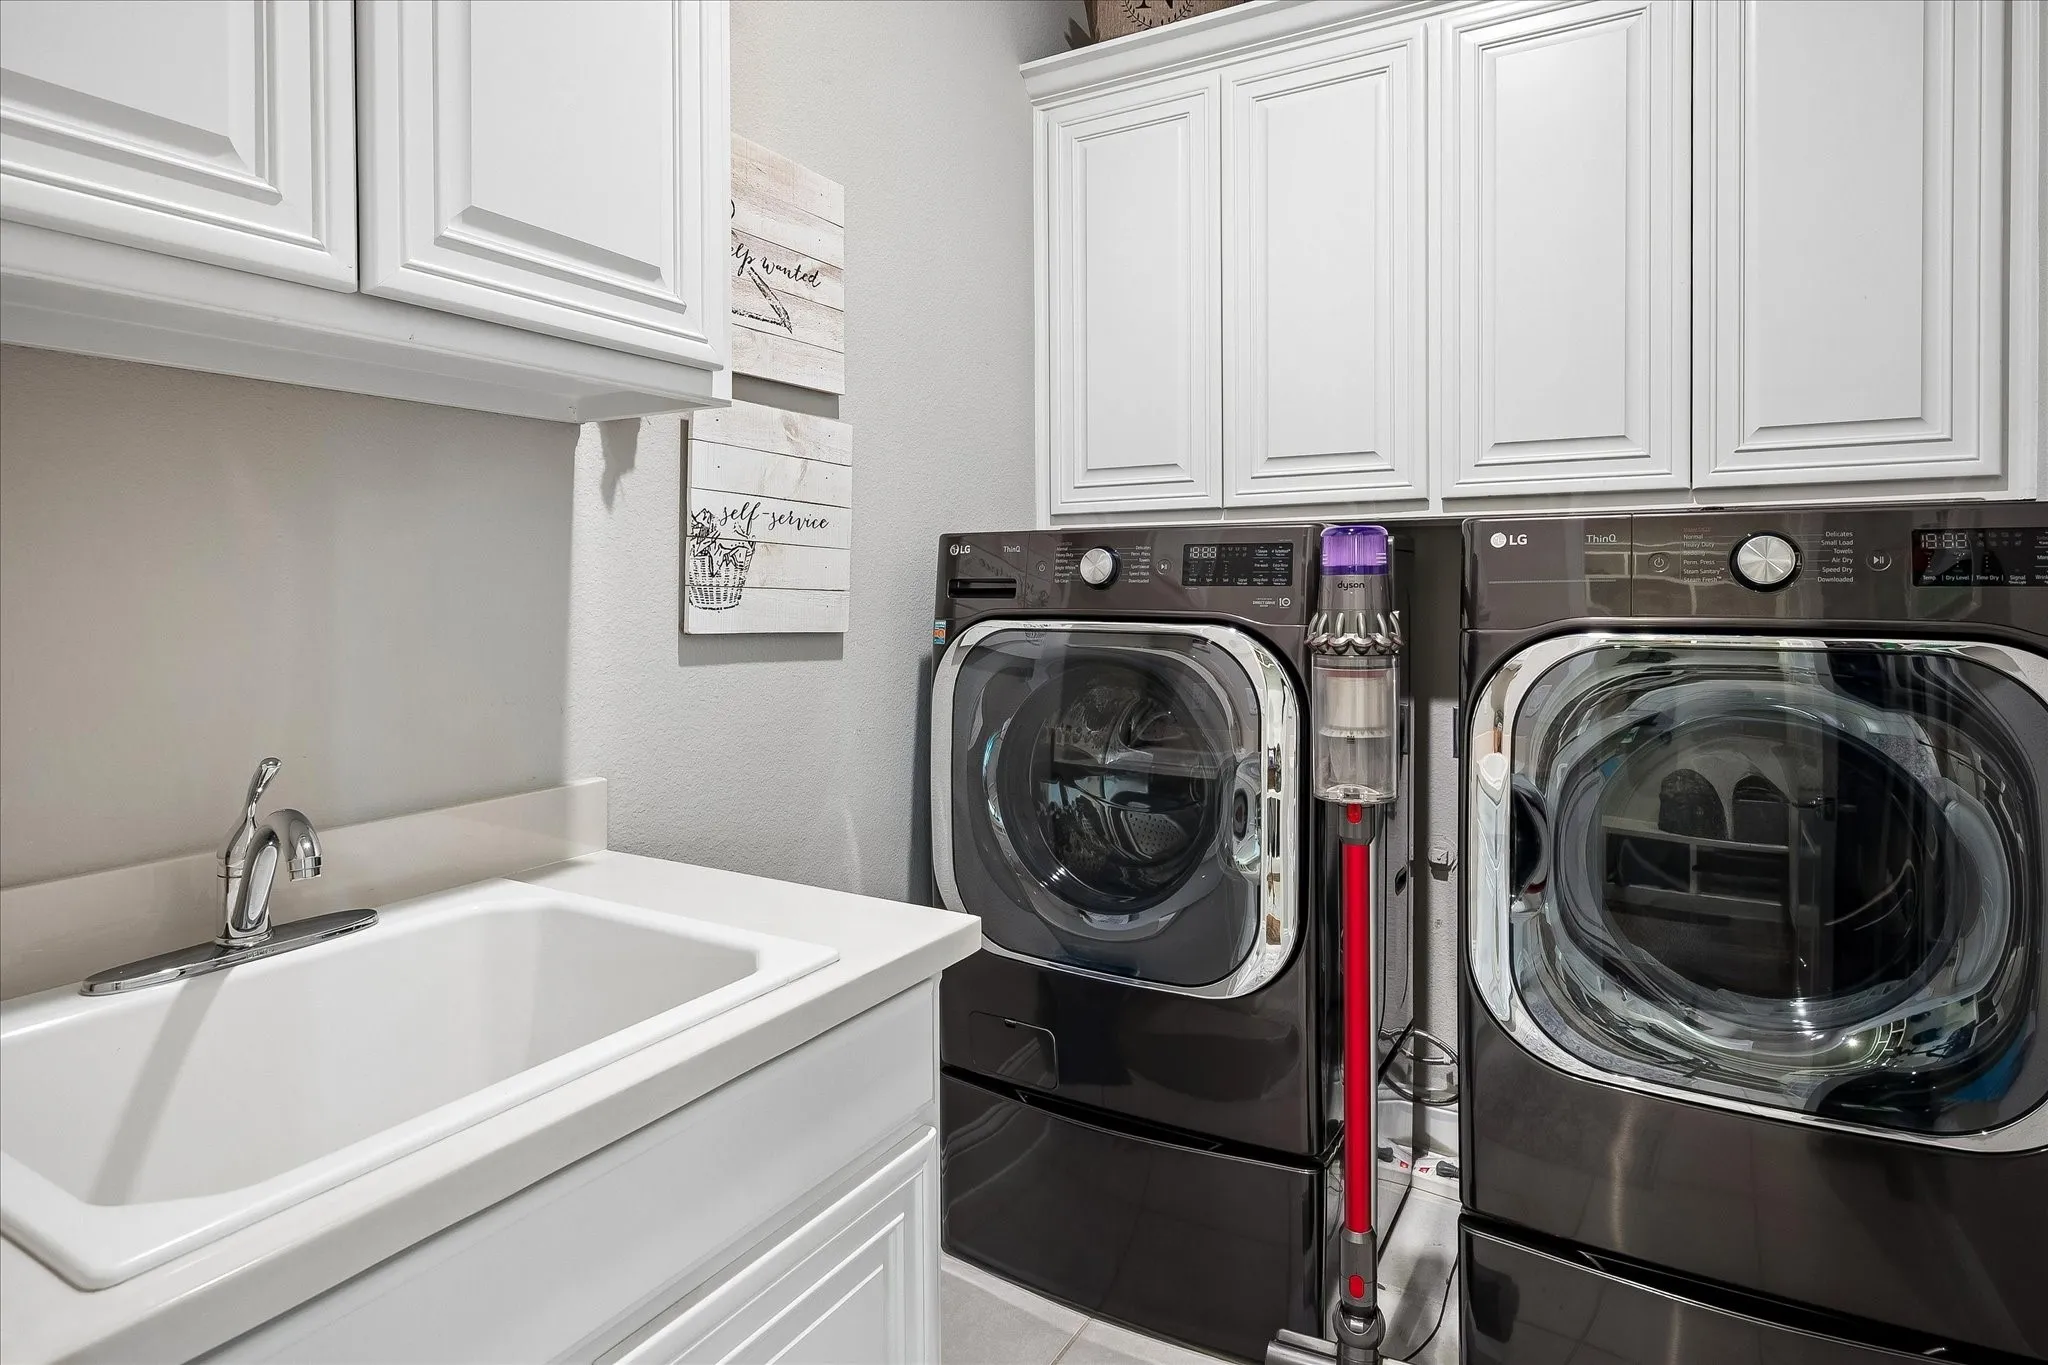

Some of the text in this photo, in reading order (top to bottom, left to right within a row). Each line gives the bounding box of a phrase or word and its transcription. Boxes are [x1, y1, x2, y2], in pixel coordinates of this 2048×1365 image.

[760, 256, 821, 288] wanted
[719, 501, 829, 536] self-service
[1586, 533, 1617, 543] ThinQ
[1003, 545, 1021, 553] ThinQ
[1683, 541, 1715, 549] Heavy Duty
[1841, 566, 1853, 574] Dry
[1945, 574, 1956, 582] Dry
[1989, 574, 2000, 582] Dry
[1337, 580, 1365, 591] dyson
